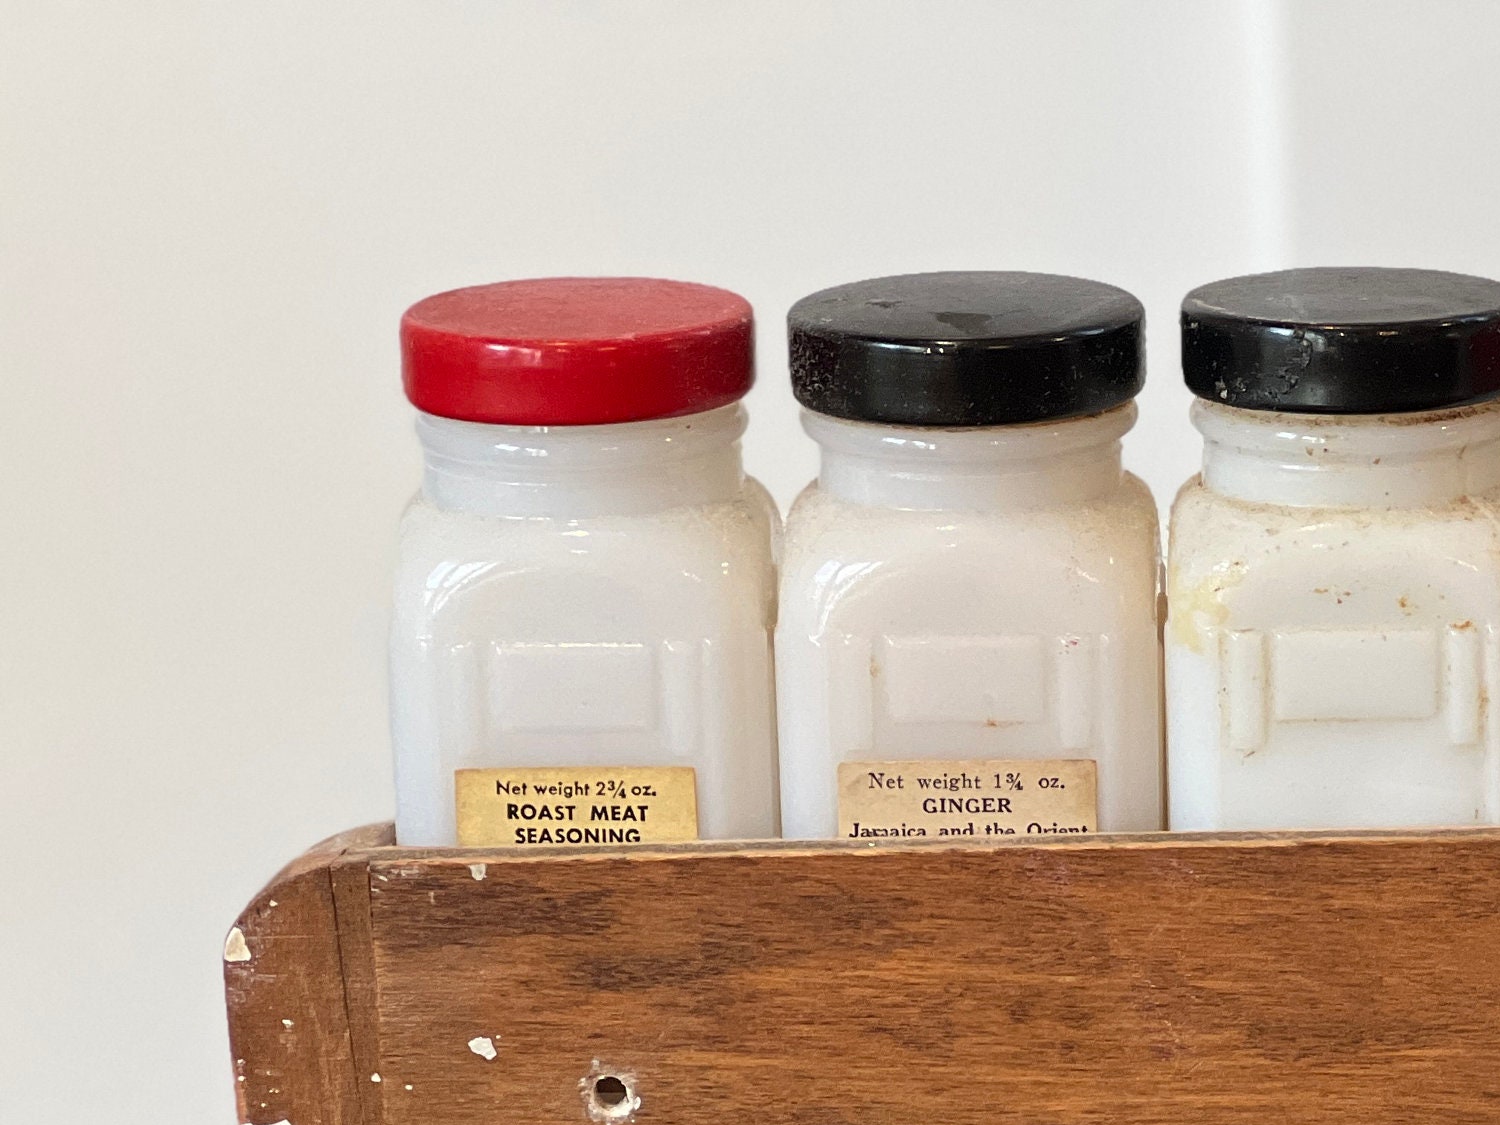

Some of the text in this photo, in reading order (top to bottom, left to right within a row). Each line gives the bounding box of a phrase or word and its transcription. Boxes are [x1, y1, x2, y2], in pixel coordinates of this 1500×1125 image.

[496, 780, 527, 796] Net
[533, 781, 590, 798] weight
[631, 787, 657, 796] oz.
[868, 773, 904, 789] Net
[917, 773, 981, 791] weight
[1038, 778, 1065, 789] oz.
[507, 804, 648, 821] ROAST MEAT
[923, 798, 1012, 813] GINGER
[515, 828, 641, 844] SEASONING
